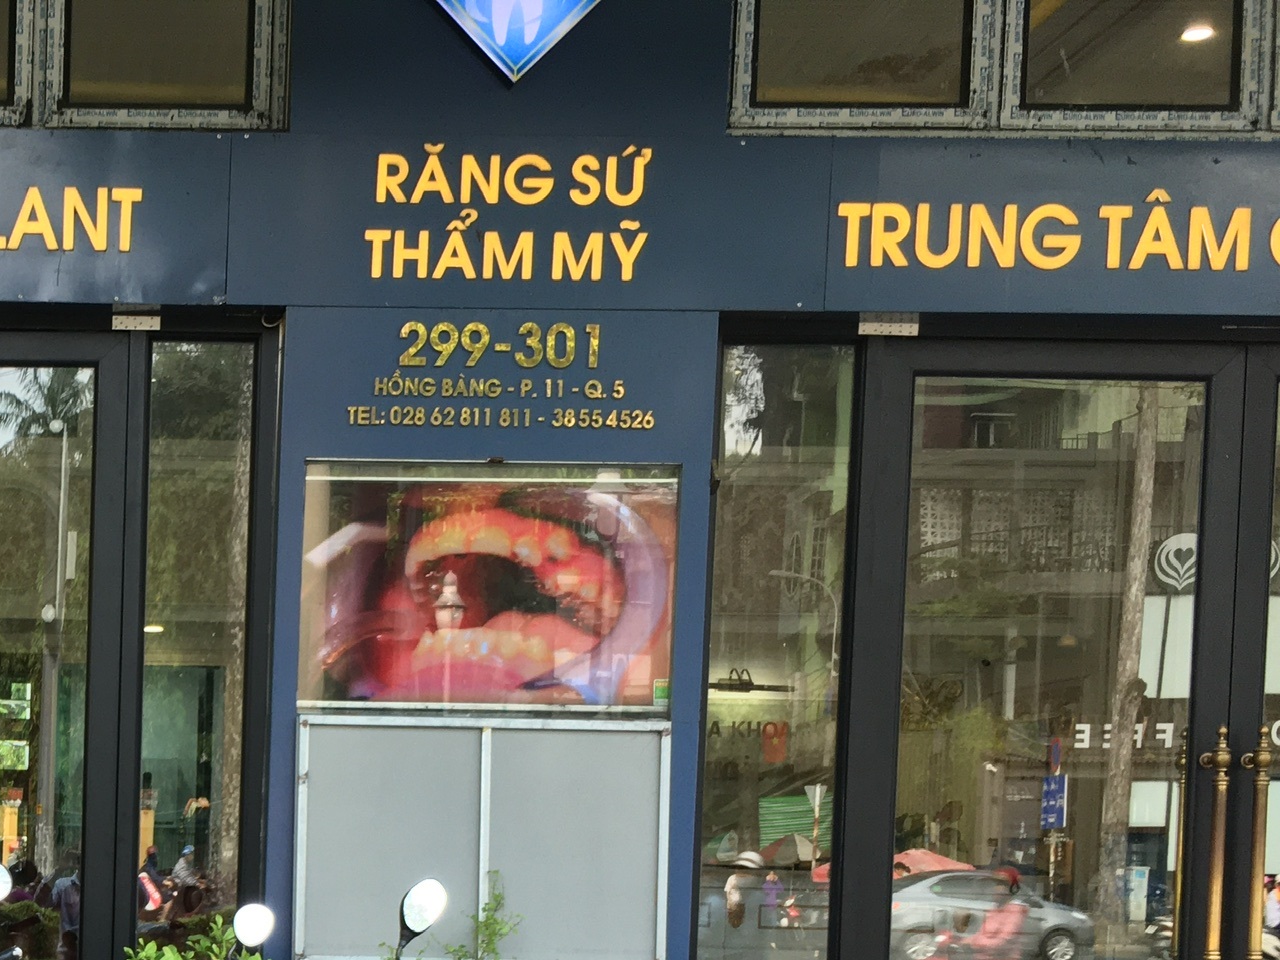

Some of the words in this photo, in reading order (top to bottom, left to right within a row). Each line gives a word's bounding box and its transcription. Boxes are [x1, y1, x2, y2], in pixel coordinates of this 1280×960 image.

[376, 143, 555, 205] RĂNG
[570, 144, 653, 206] SỨ
[364, 208, 535, 280] THẨM
[551, 219, 649, 282] MỸ
[837, 202, 1082, 270] TRUNG
[1098, 188, 1252, 272] TÂM
[398, 320, 601, 368] 299-301
[374, 369, 437, 397] HỒNG
[441, 372, 503, 398] BÀNG
[520, 378, 538, 398] P.
[545, 378, 564, 398] 11
[584, 379, 607, 399] Q.
[612, 380, 626, 399] 5
[347, 405, 386, 425] TEL:
[390, 405, 426, 426] 028
[430, 406, 455, 426] 62
[460, 407, 492, 427] 811
[499, 407, 531, 427] 811
